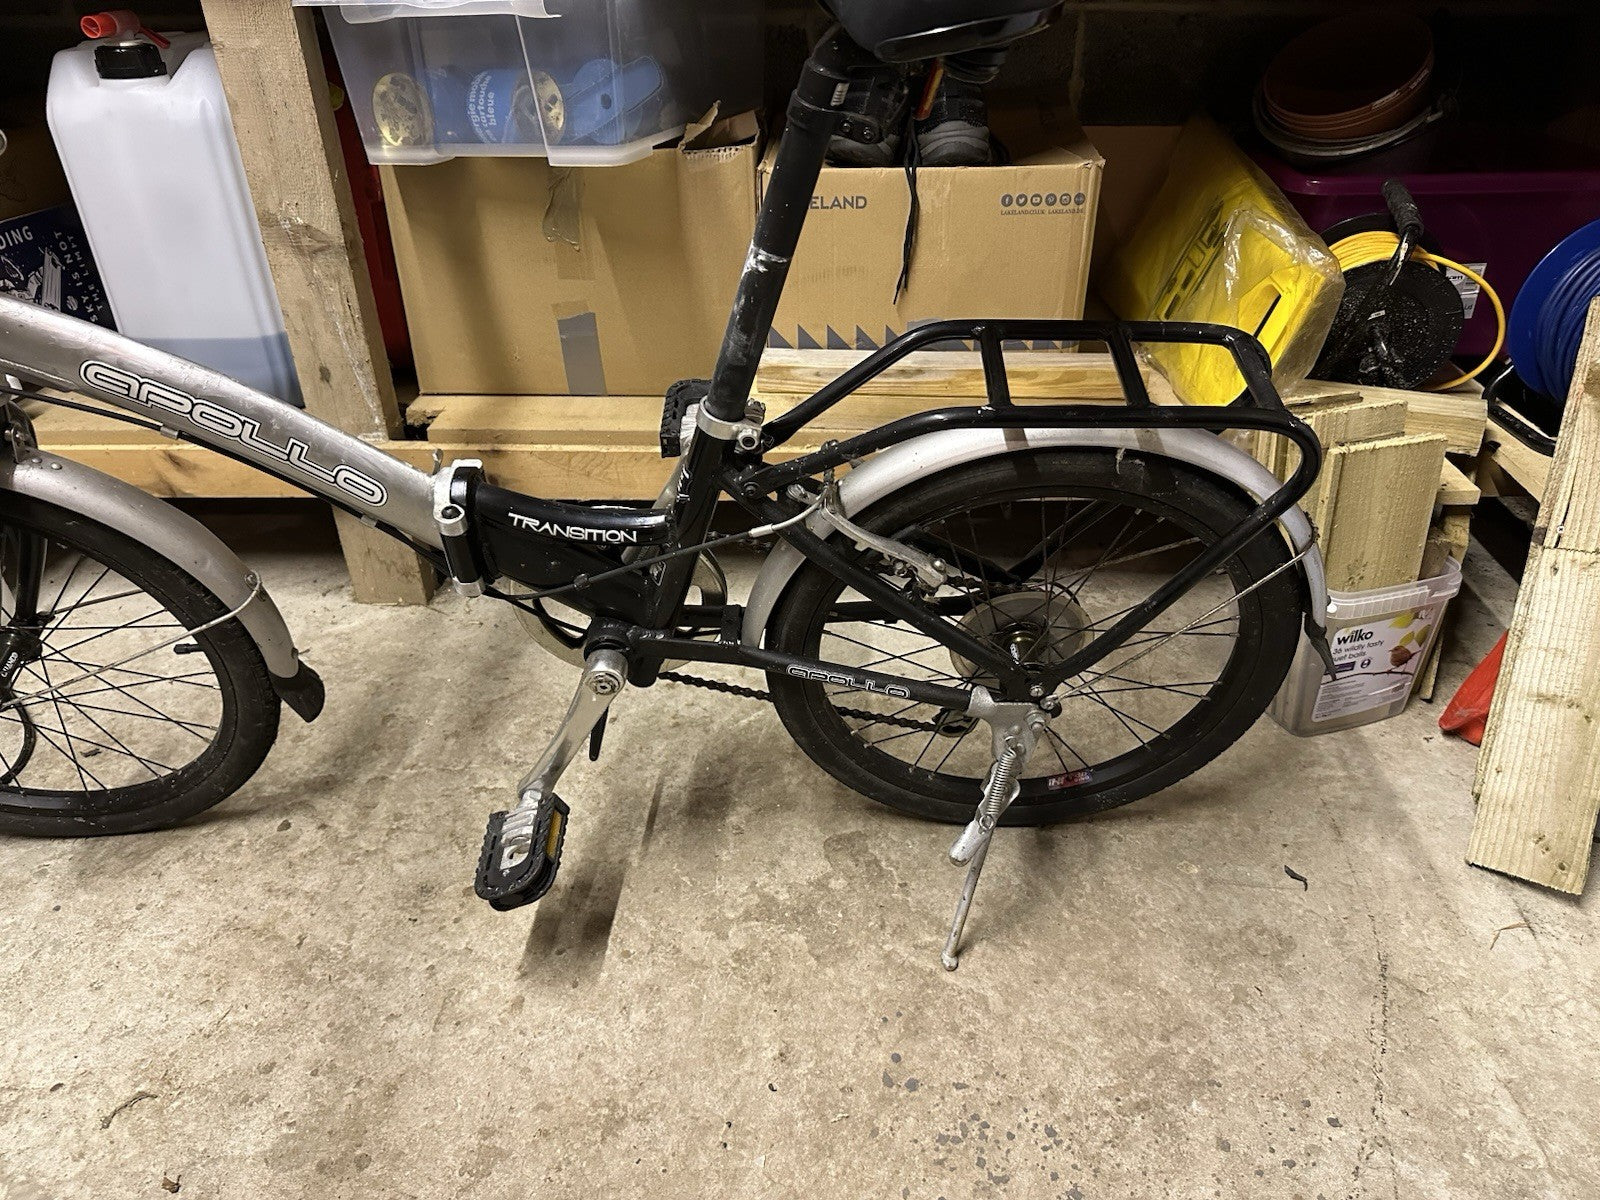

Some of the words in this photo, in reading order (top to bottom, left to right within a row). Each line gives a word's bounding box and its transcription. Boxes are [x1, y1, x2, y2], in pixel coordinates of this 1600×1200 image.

[487, 92, 497, 126] bleue
[809, 195, 868, 210] ELAND
[54, 230, 74, 265] NOT
[66, 235, 90, 277] LIMIT
[71, 271, 83, 287] IS
[81, 295, 98, 323] SKY
[88, 283, 103, 311] THE
[79, 360, 388, 507] APOLLO
[508, 512, 637, 543] TRANSITION
[1332, 647, 1343, 655] 36
[1344, 643, 1366, 653] wildly
[1366, 639, 1385, 649] tasty
[1337, 629, 1374, 645] wilko
[1332, 653, 1347, 662] uet
[786, 664, 910, 699] APOLLO
